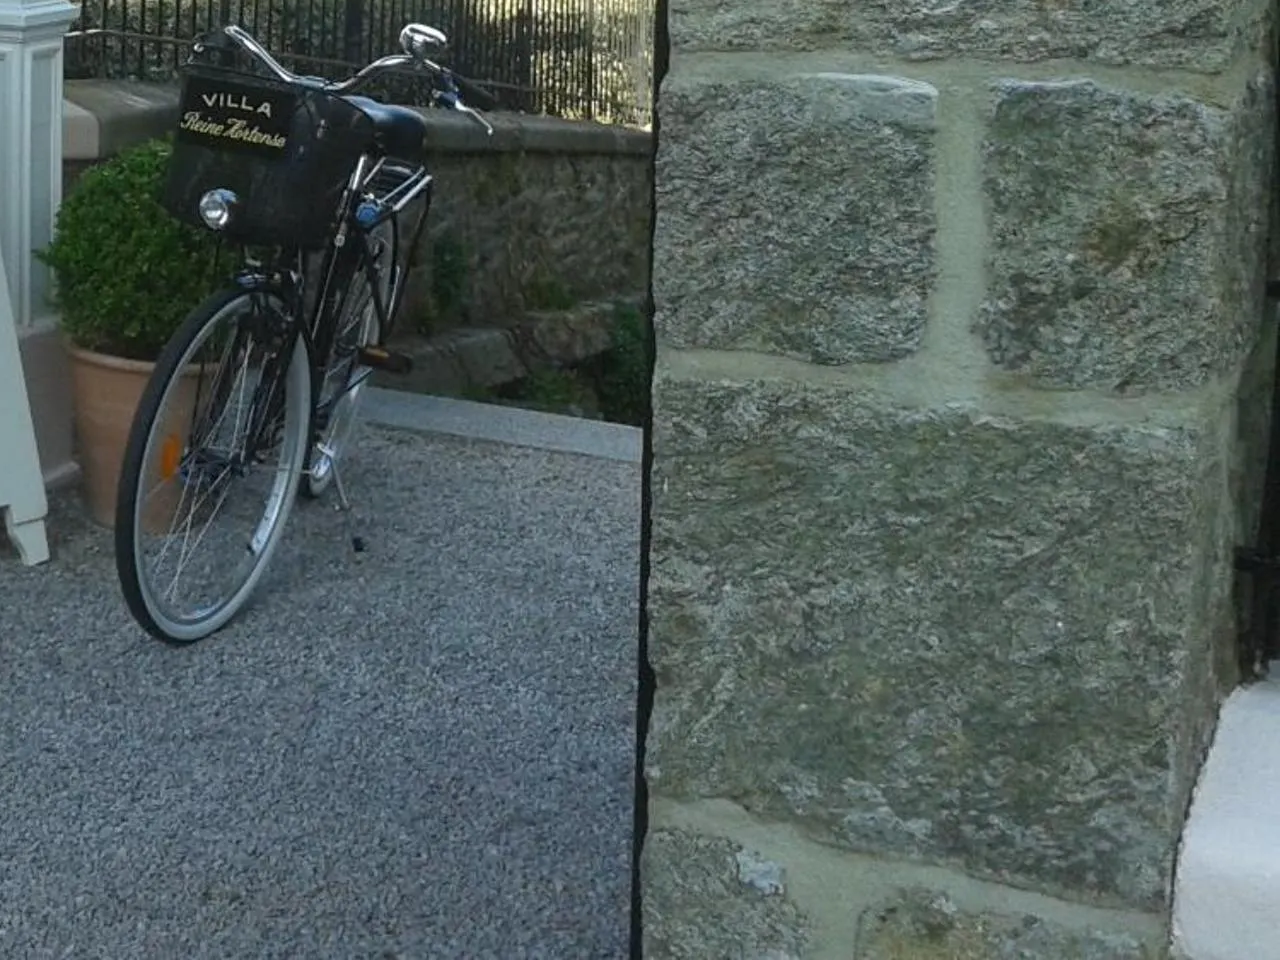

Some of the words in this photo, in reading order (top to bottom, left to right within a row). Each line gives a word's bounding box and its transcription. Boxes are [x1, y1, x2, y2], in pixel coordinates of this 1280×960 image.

[201, 92, 272, 119] VILLA
[180, 111, 225, 137] Reine
[223, 118, 287, 149] Hortense
